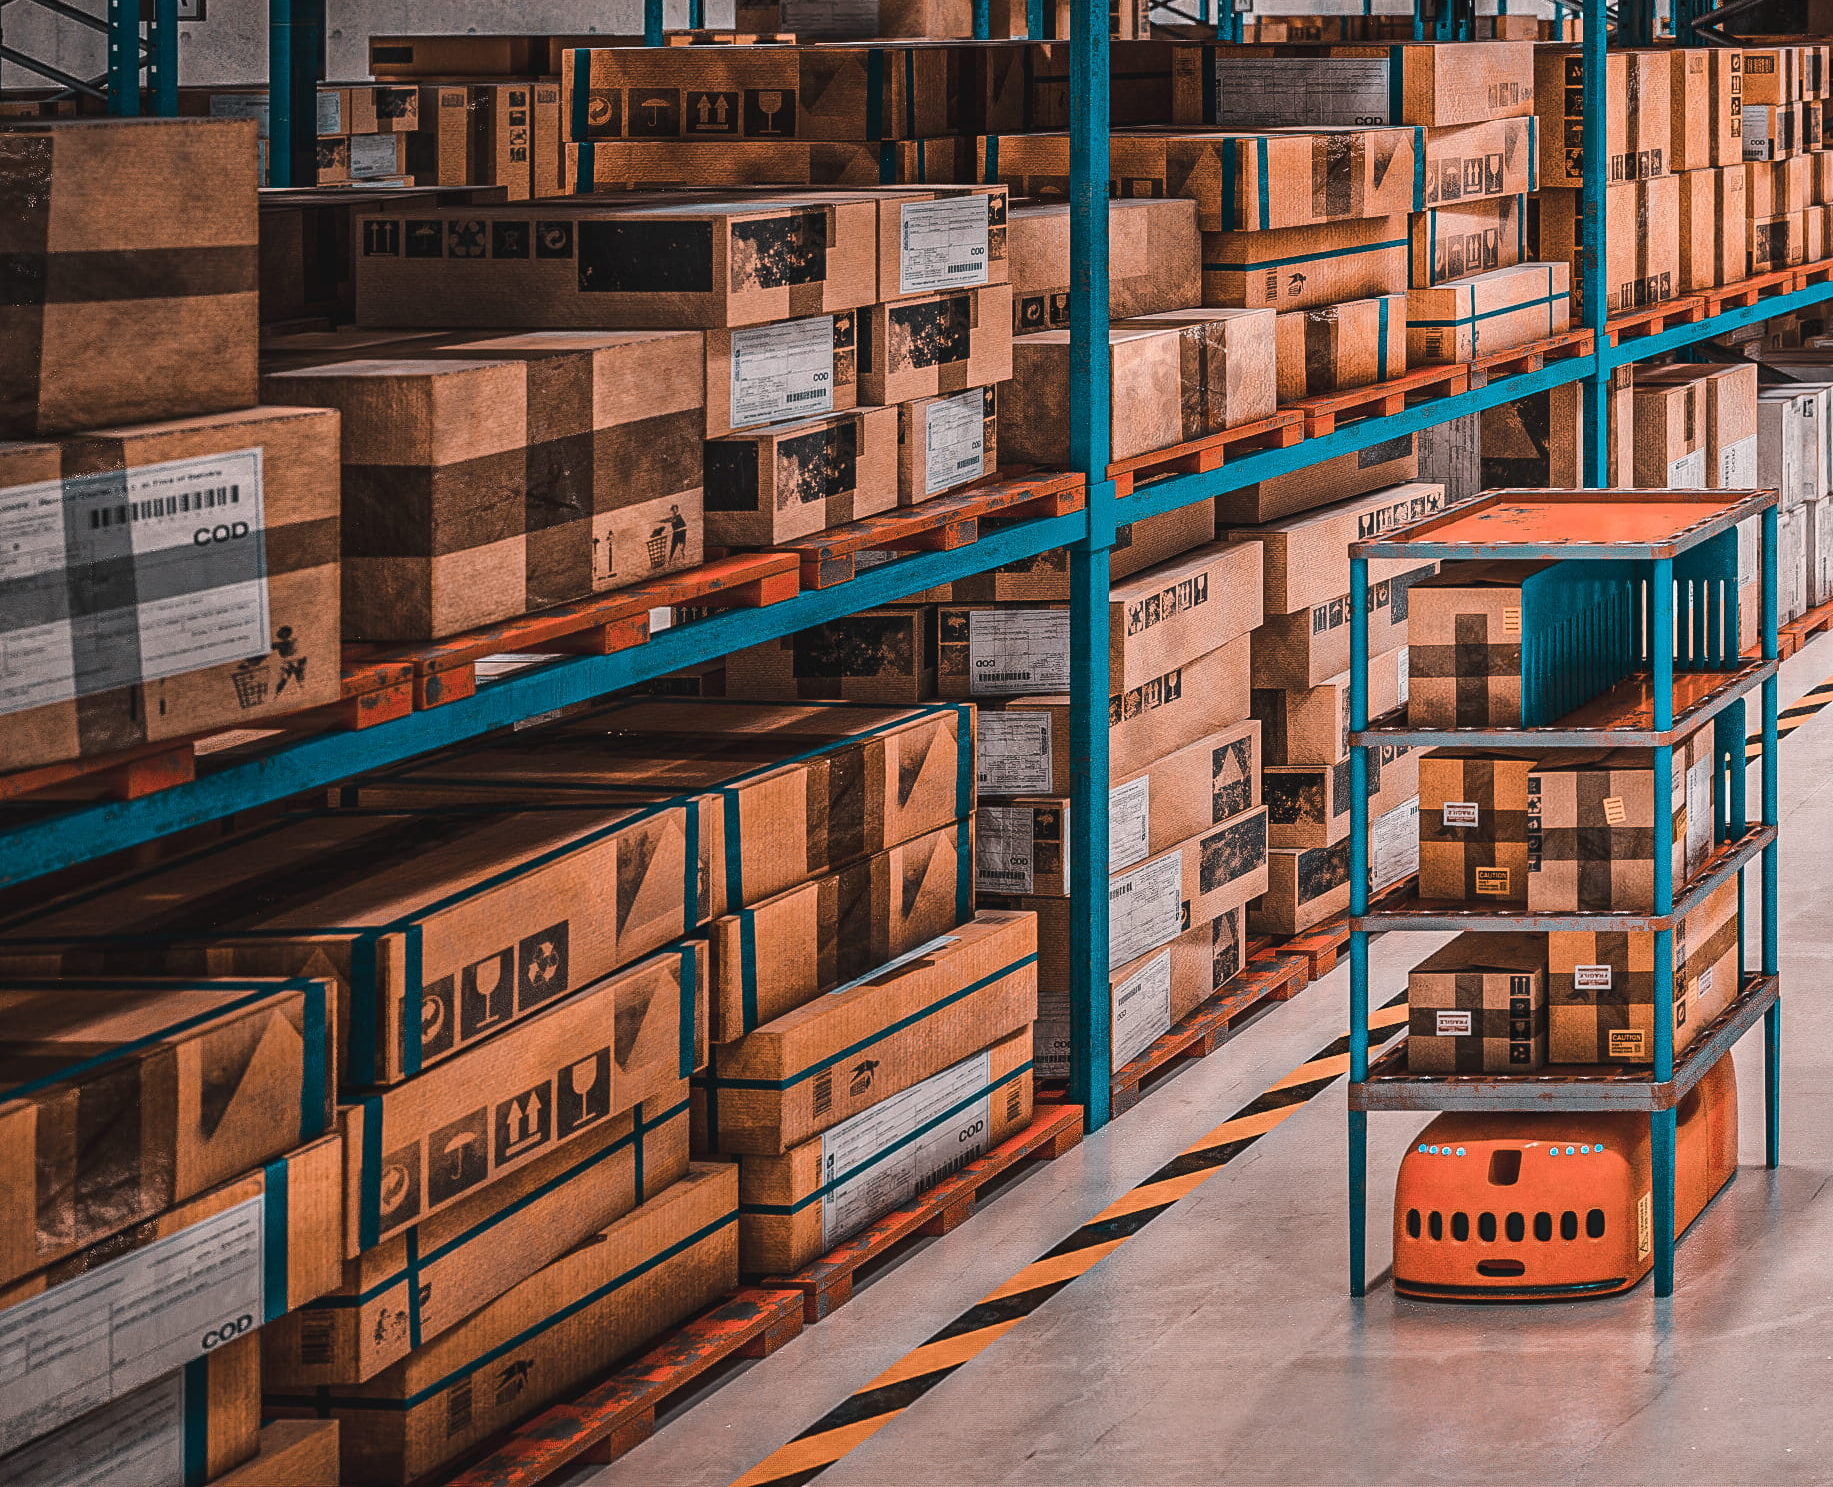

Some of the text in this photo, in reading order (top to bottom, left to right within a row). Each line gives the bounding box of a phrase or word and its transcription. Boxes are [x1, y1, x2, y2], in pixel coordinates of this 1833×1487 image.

[971, 247, 984, 255] COD
[813, 372, 829, 382] COD
[972, 441, 981, 449] COD
[194, 521, 248, 546] COD
[1010, 857, 1028, 865] COD
[1612, 1033, 1642, 1042] CAUTION
[959, 1120, 984, 1143] COD
[202, 1314, 252, 1350] COD
